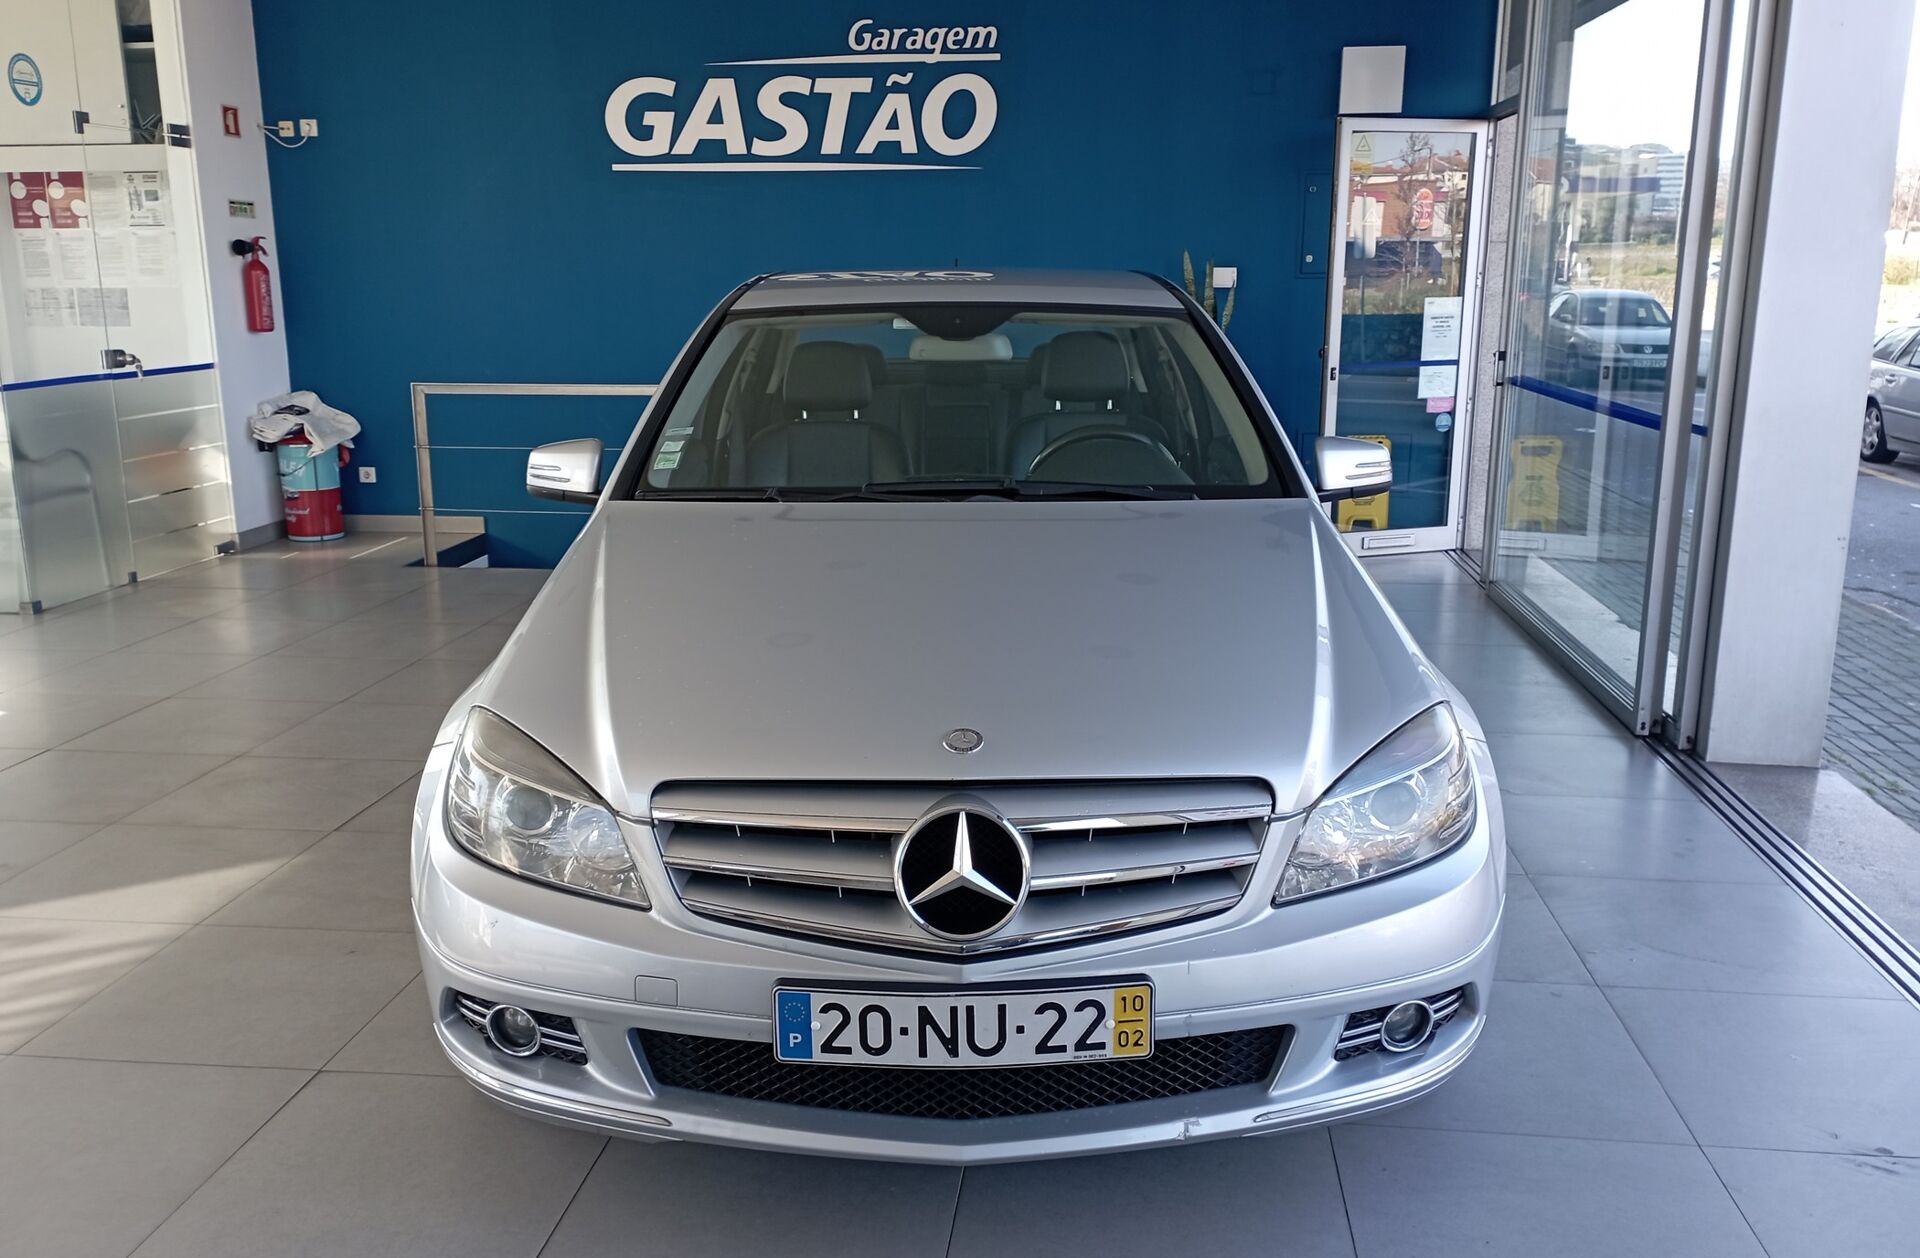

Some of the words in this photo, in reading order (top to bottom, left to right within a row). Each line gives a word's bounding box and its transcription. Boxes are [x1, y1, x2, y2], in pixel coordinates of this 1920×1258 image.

[847, 18, 998, 63] Garagem
[604, 72, 998, 157] GASTÃO
[1120, 994, 1145, 1014] 10
[788, 1032, 802, 1048] P
[1117, 1029, 1145, 1049] 02
